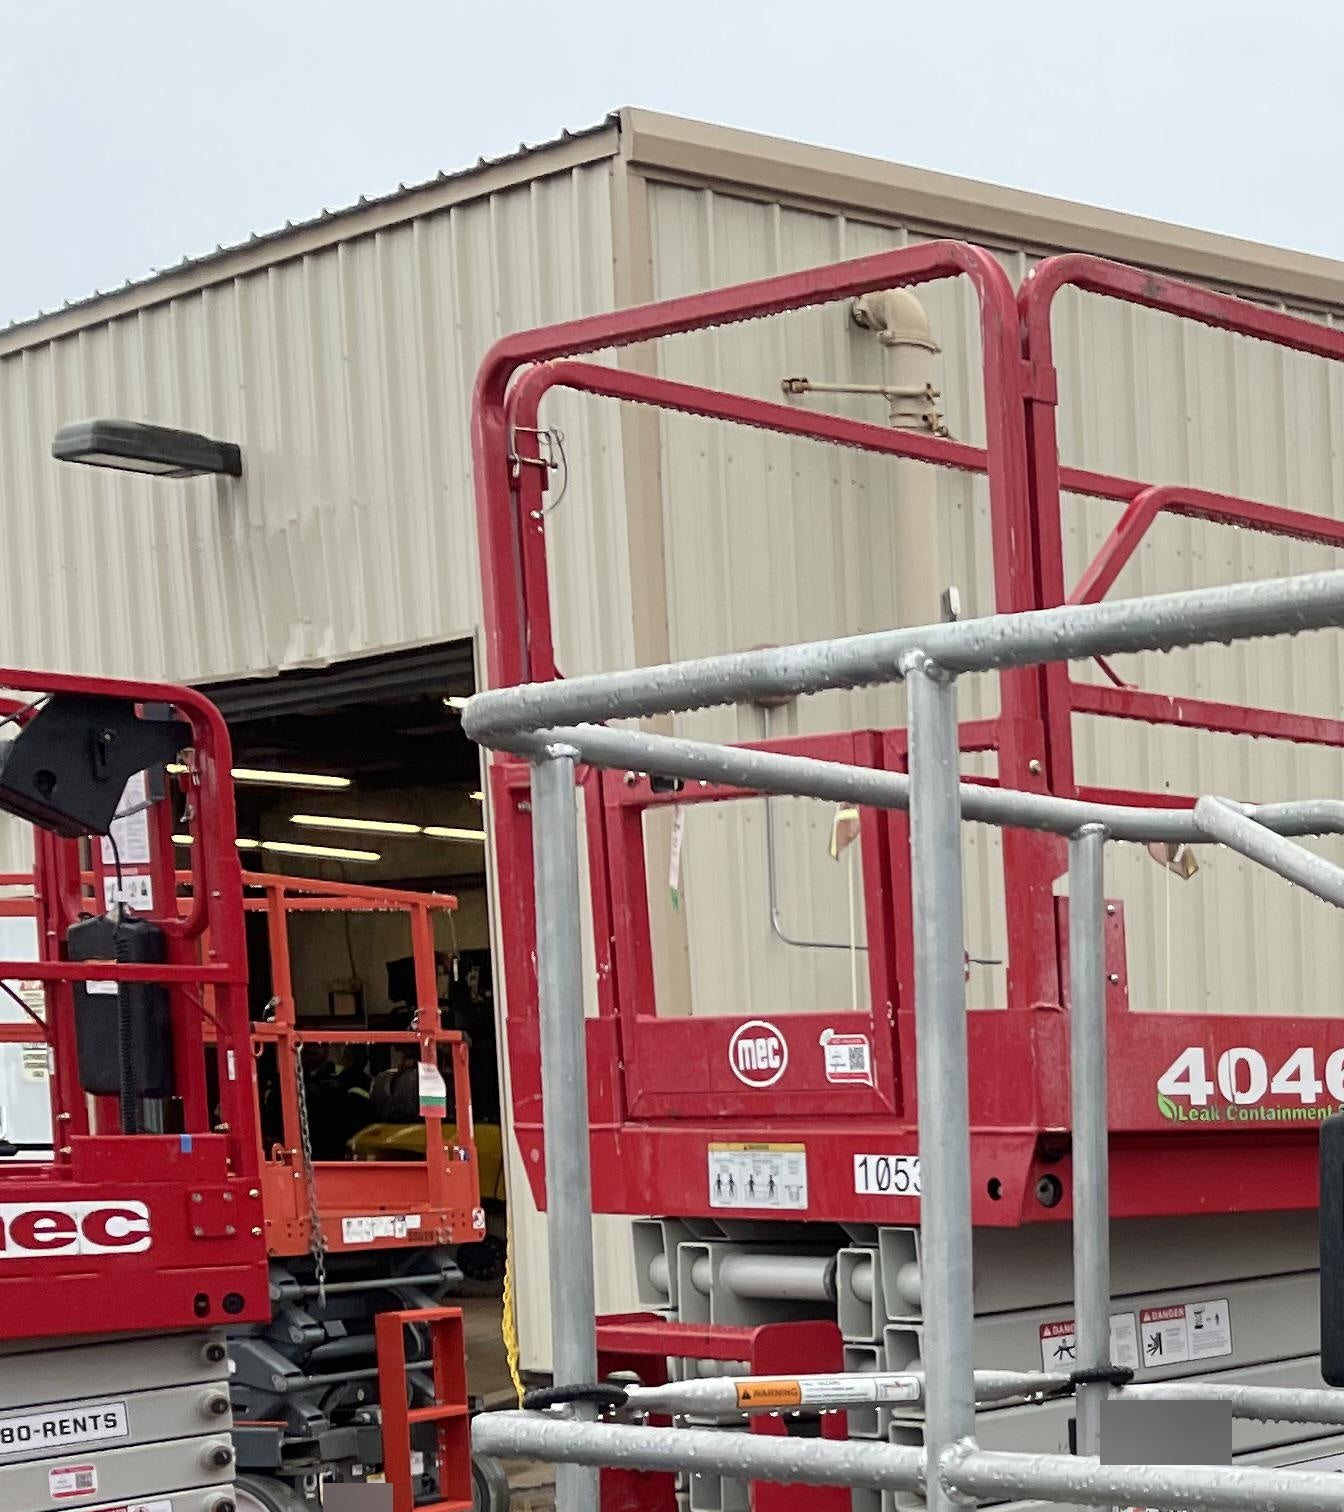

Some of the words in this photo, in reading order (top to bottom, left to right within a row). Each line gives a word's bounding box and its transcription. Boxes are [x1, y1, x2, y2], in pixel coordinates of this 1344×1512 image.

[1178, 1104, 1219, 1121] Leak
[1227, 1104, 1332, 1121] Containment
[0, 1208, 151, 1250] ec
[1152, 1308, 1185, 1321] DANGER
[1052, 1323, 1075, 1336] DANG
[753, 1387, 799, 1398] WARNING
